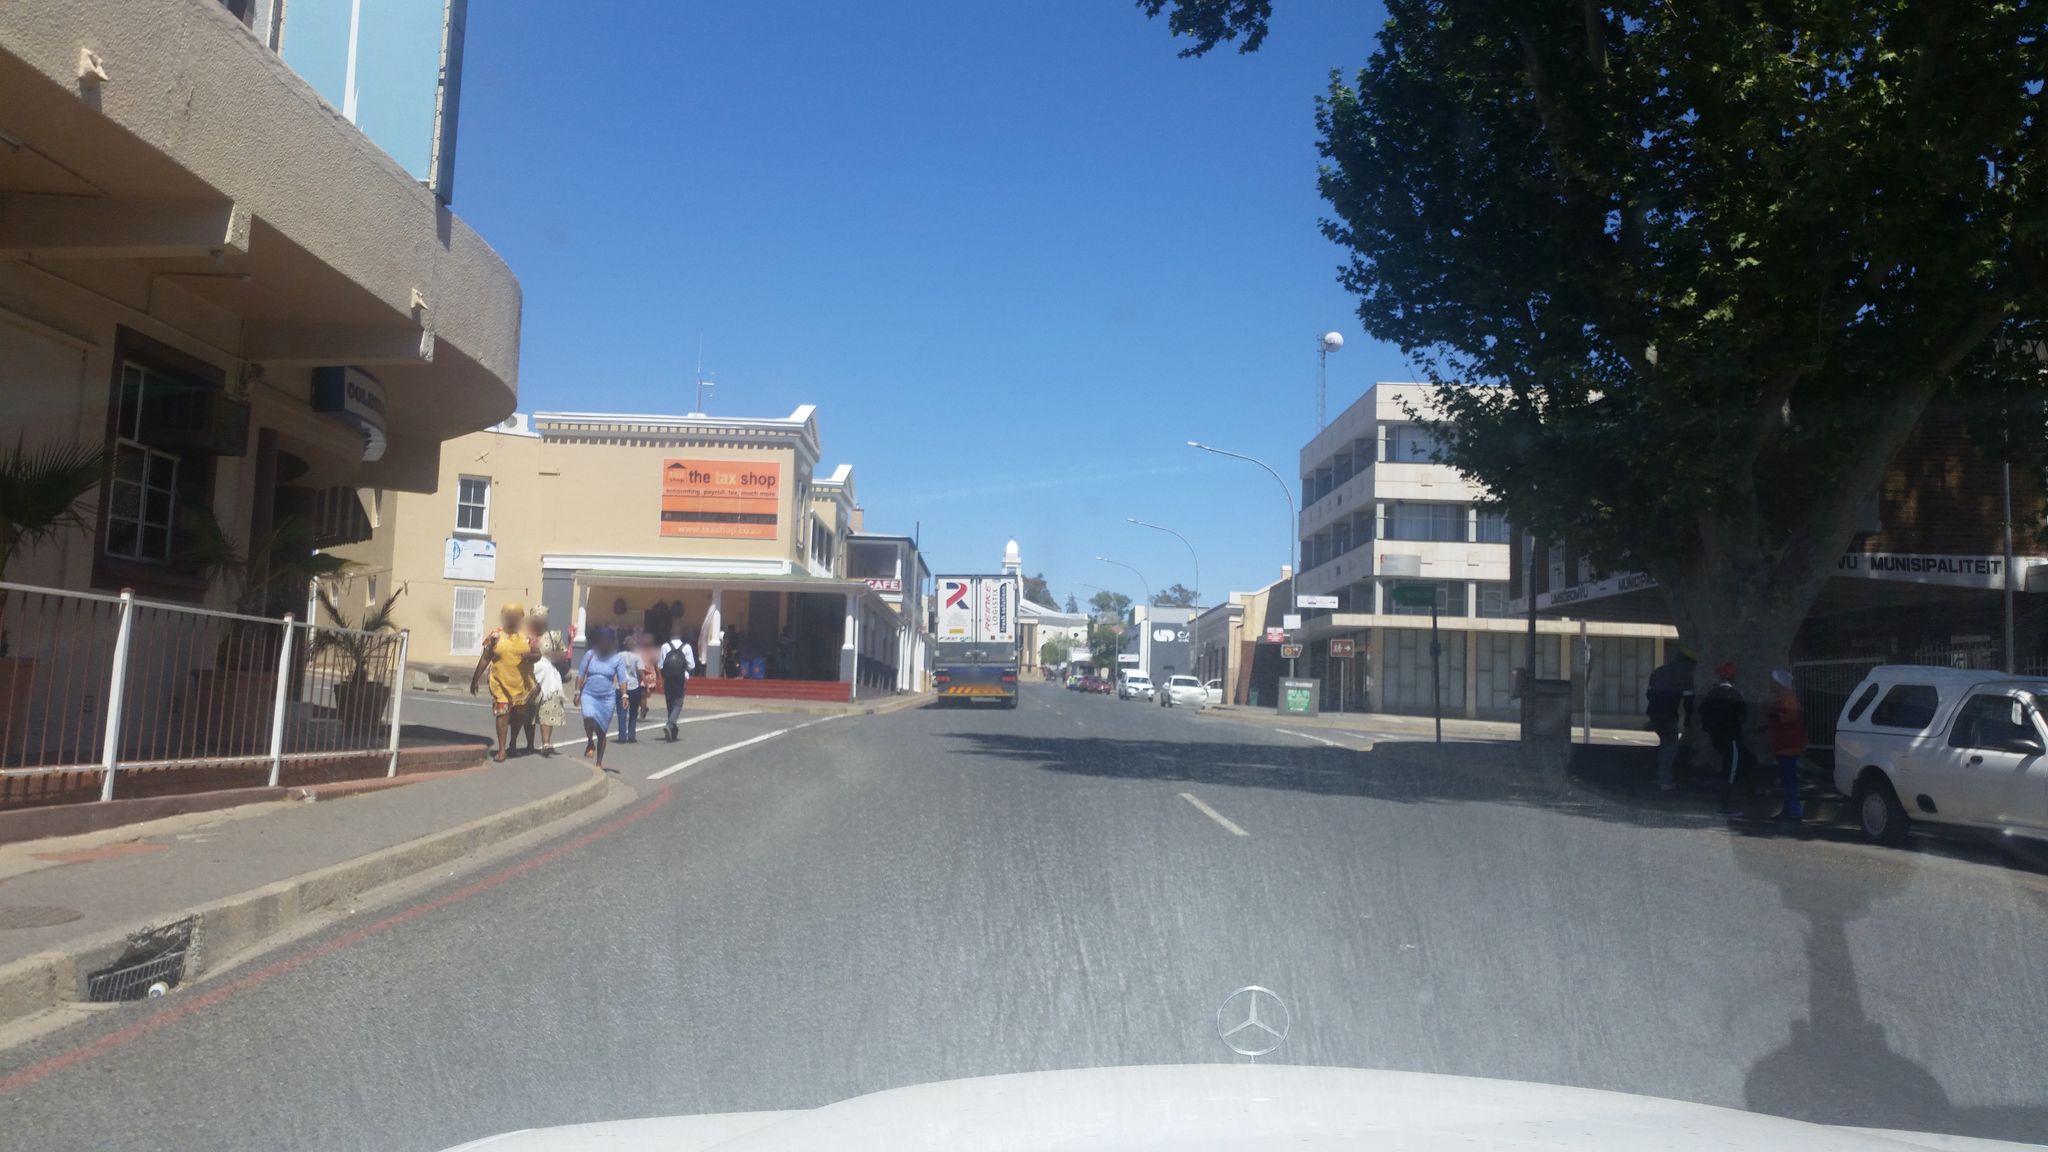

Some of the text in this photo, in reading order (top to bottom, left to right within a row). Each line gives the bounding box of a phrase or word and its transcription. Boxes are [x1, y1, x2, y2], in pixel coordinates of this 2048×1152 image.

[688, 469, 776, 490] the tax shop
[1870, 557, 2002, 575] MUNISIPALITEIT
[867, 580, 898, 589] CAFE
